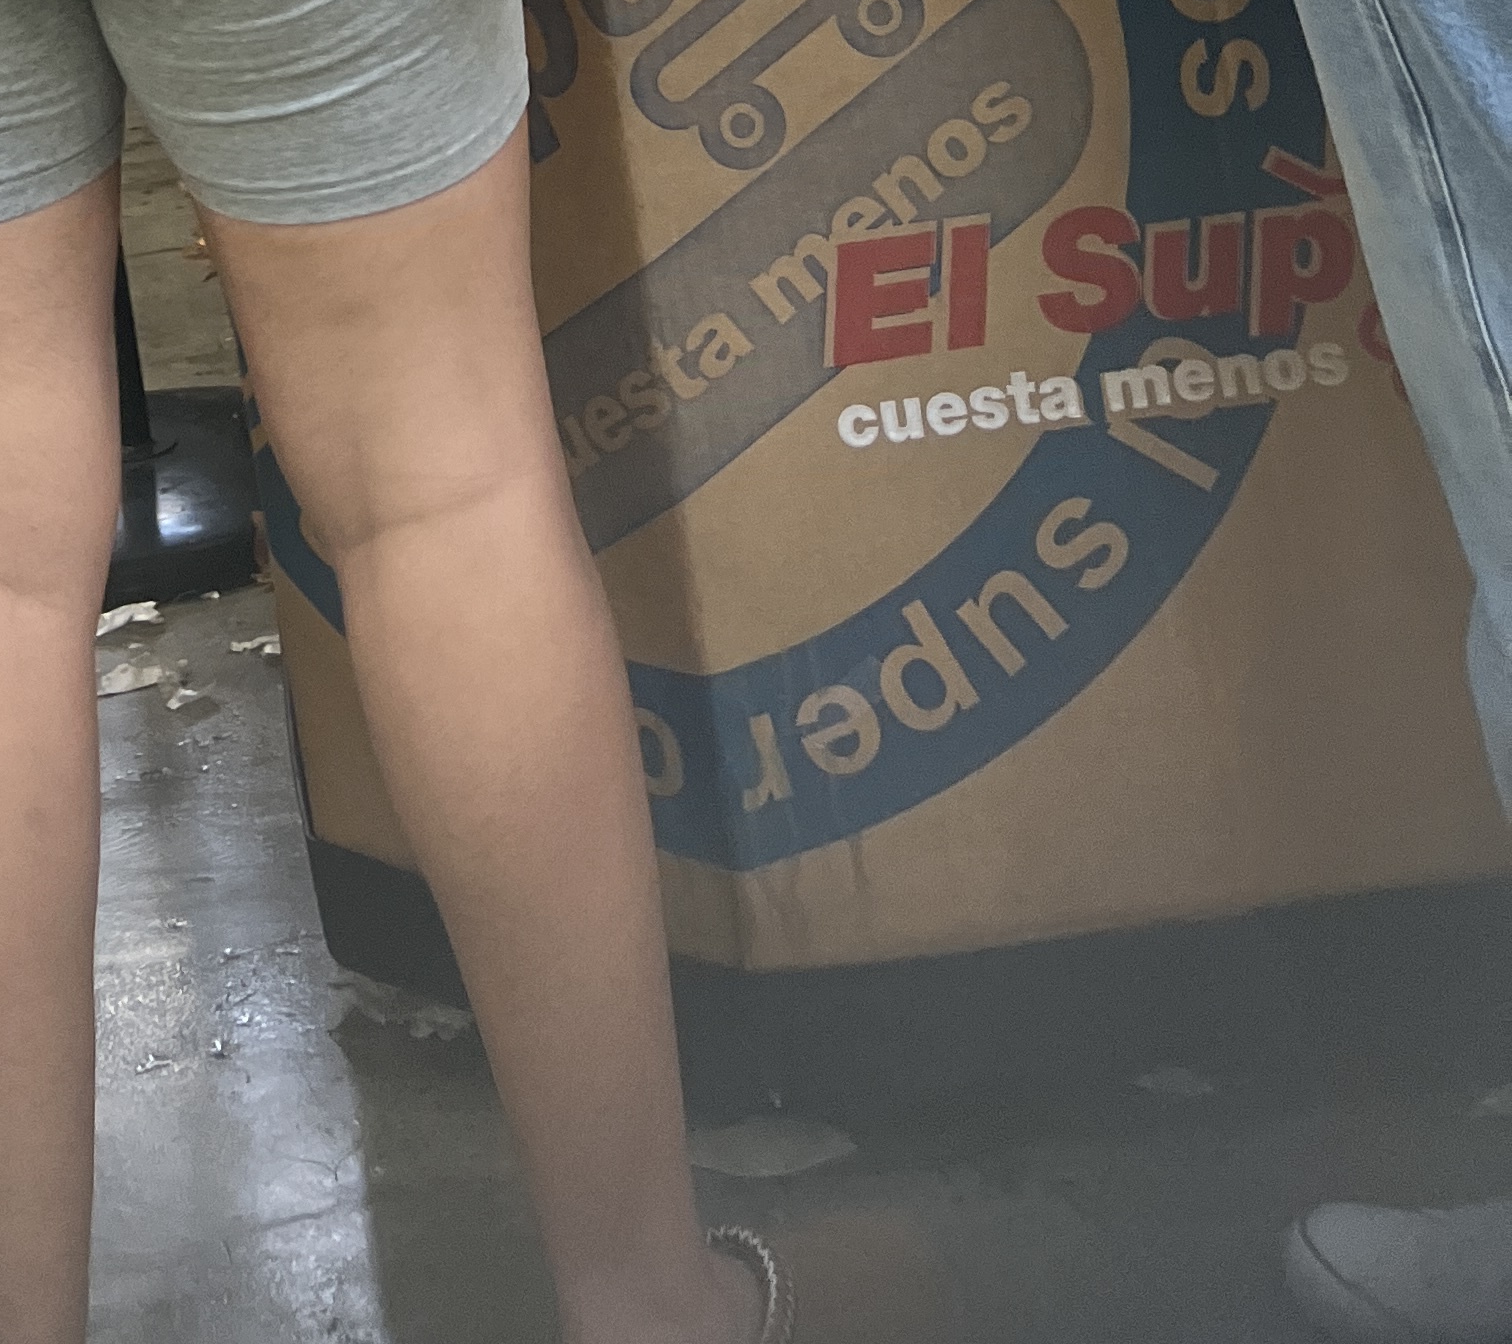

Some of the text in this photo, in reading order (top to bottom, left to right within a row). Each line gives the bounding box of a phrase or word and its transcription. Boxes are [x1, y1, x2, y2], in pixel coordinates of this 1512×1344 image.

[826, 204, 1356, 368] El Sup
[564, 312, 756, 476] uesta
[837, 341, 1349, 448] cuesta menos
[742, 496, 1130, 813] super
